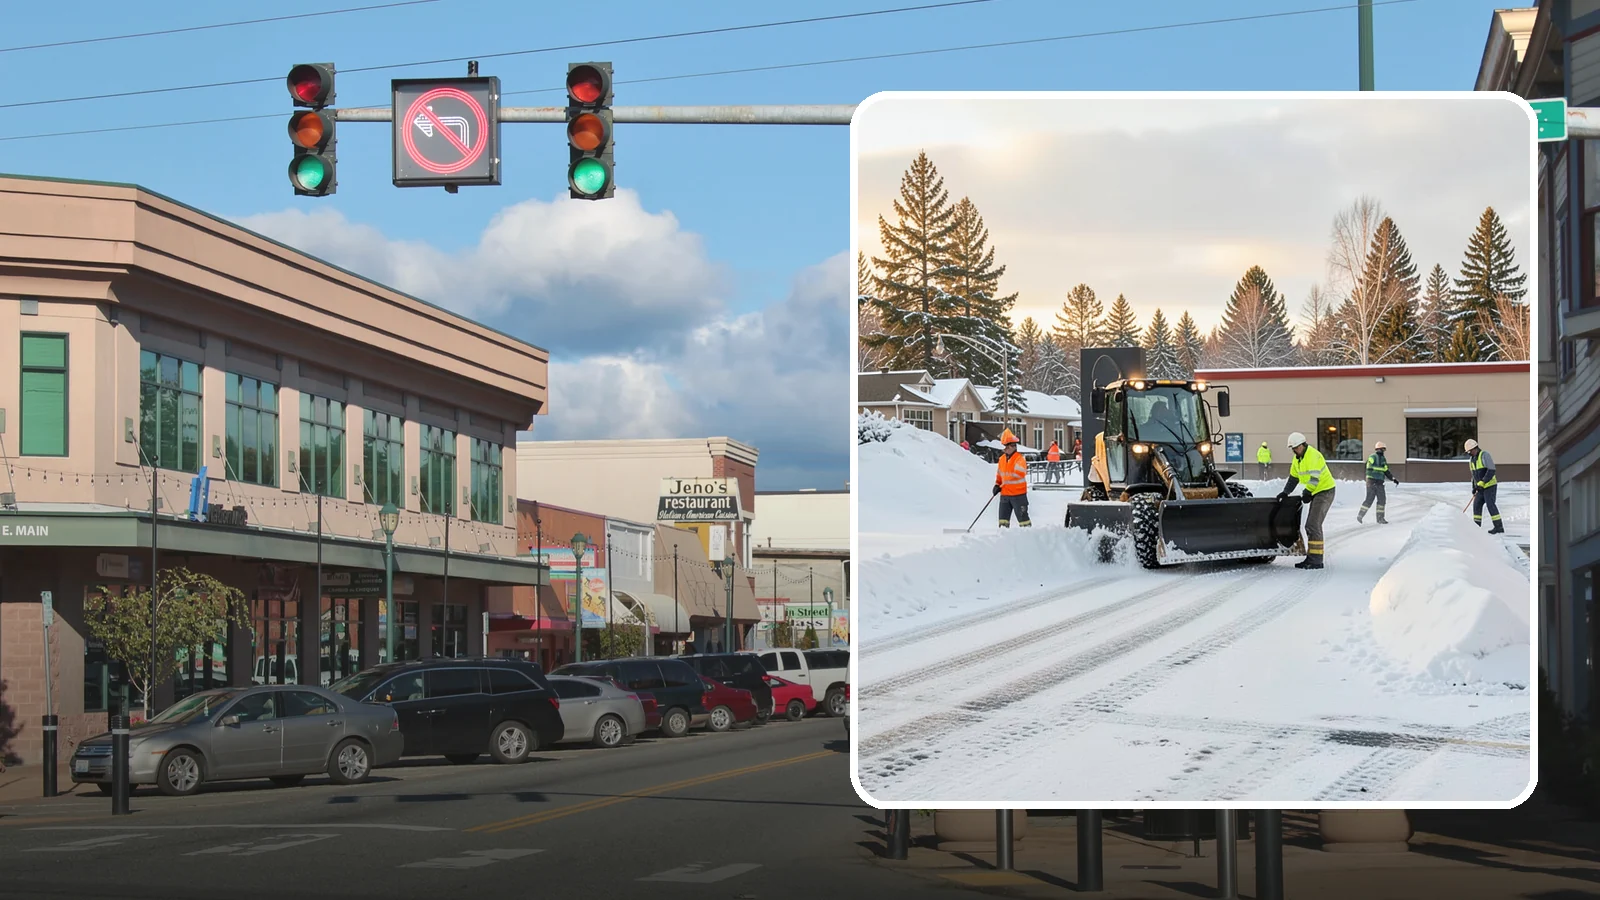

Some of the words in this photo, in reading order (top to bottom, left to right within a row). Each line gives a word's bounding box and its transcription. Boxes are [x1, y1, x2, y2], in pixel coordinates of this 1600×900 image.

[670, 480, 727, 494] Jeno's
[665, 497, 730, 508] restaurant
[658, 510, 681, 519] Italian
[686, 510, 714, 519] American
[715, 510, 737, 519] Cuisine
[2, 525, 13, 536] E.
[15, 525, 49, 536] MAIN
[797, 607, 828, 616] Street
